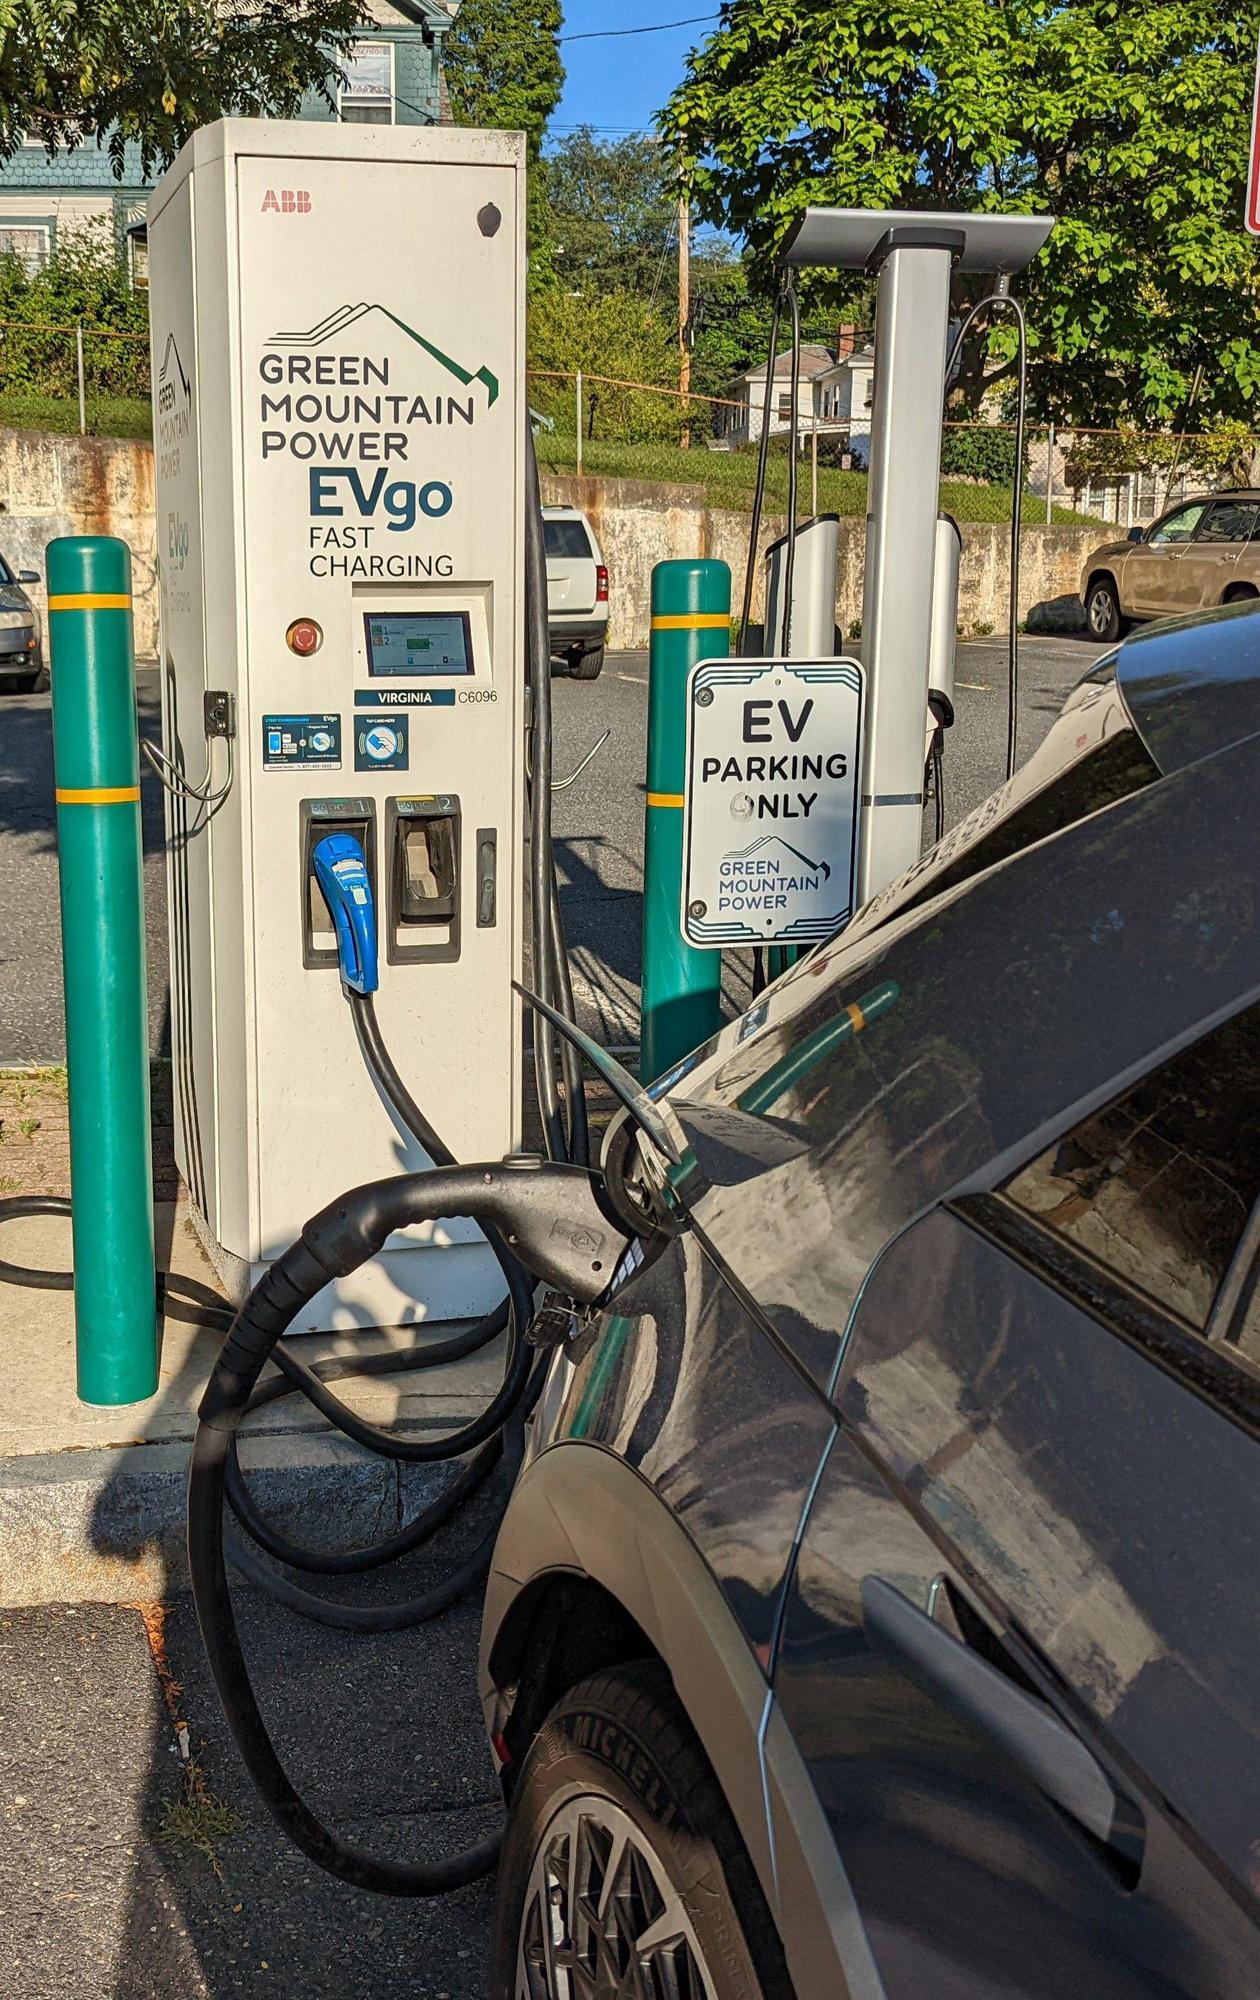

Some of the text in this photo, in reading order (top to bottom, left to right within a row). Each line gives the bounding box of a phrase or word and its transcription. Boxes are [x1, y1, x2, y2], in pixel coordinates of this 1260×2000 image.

[261, 190, 312, 213] ABB
[259, 354, 389, 385] GREEN
[159, 381, 176, 415] GREEN
[261, 394, 474, 425] MOUNTAIN
[262, 431, 408, 461] POWER
[309, 467, 453, 532] EVgo
[309, 527, 375, 549] FAST
[309, 555, 453, 577] CHARGING
[378, 692, 433, 704] VIRGINIA
[458, 690, 498, 704] C6096
[742, 699, 815, 743] EV
[702, 754, 847, 783] PARKING
[440, 798, 453, 811] 2
[730, 792, 818, 819] NLY
[719, 860, 780, 876] GREEN
[719, 876, 819, 894] MOUNTAIN
[718, 894, 787, 911] POWER
